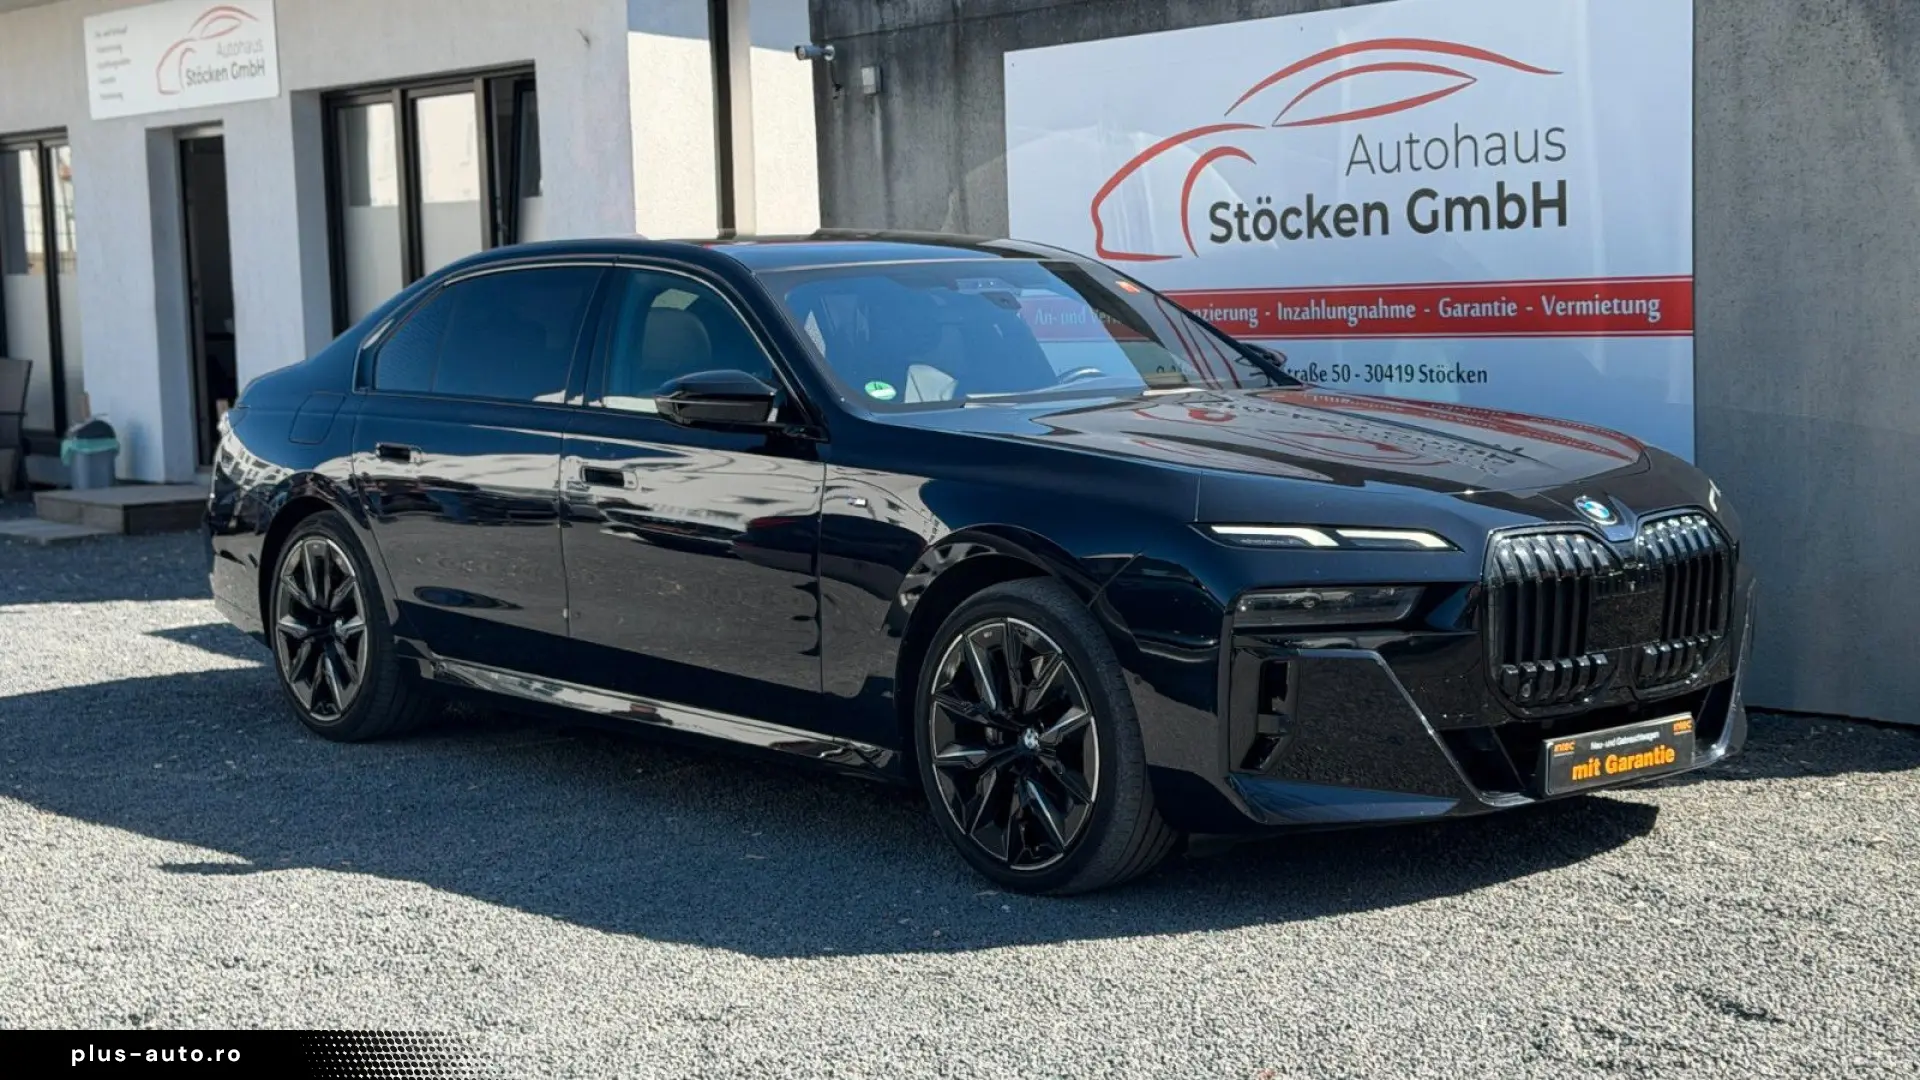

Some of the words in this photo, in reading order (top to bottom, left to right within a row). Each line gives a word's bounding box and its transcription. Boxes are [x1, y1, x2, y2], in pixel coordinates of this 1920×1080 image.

[185, 64, 229, 87] Stöcken
[231, 57, 266, 79] GmbH
[1345, 122, 1567, 176] Autohaus
[1209, 193, 1390, 244] Stöcken
[1406, 179, 1568, 235] GmbH
[1192, 302, 1258, 328] nzierung
[1277, 297, 1416, 327] Inzahlungnahme
[1438, 295, 1518, 318] Garantie
[1541, 293, 1662, 323] Vermietung
[1331, 363, 1351, 383] 50
[1364, 363, 1415, 384] 30419
[1418, 361, 1488, 384] Stöcken
[1572, 757, 1601, 781] mit
[1605, 744, 1676, 775] Garantie
